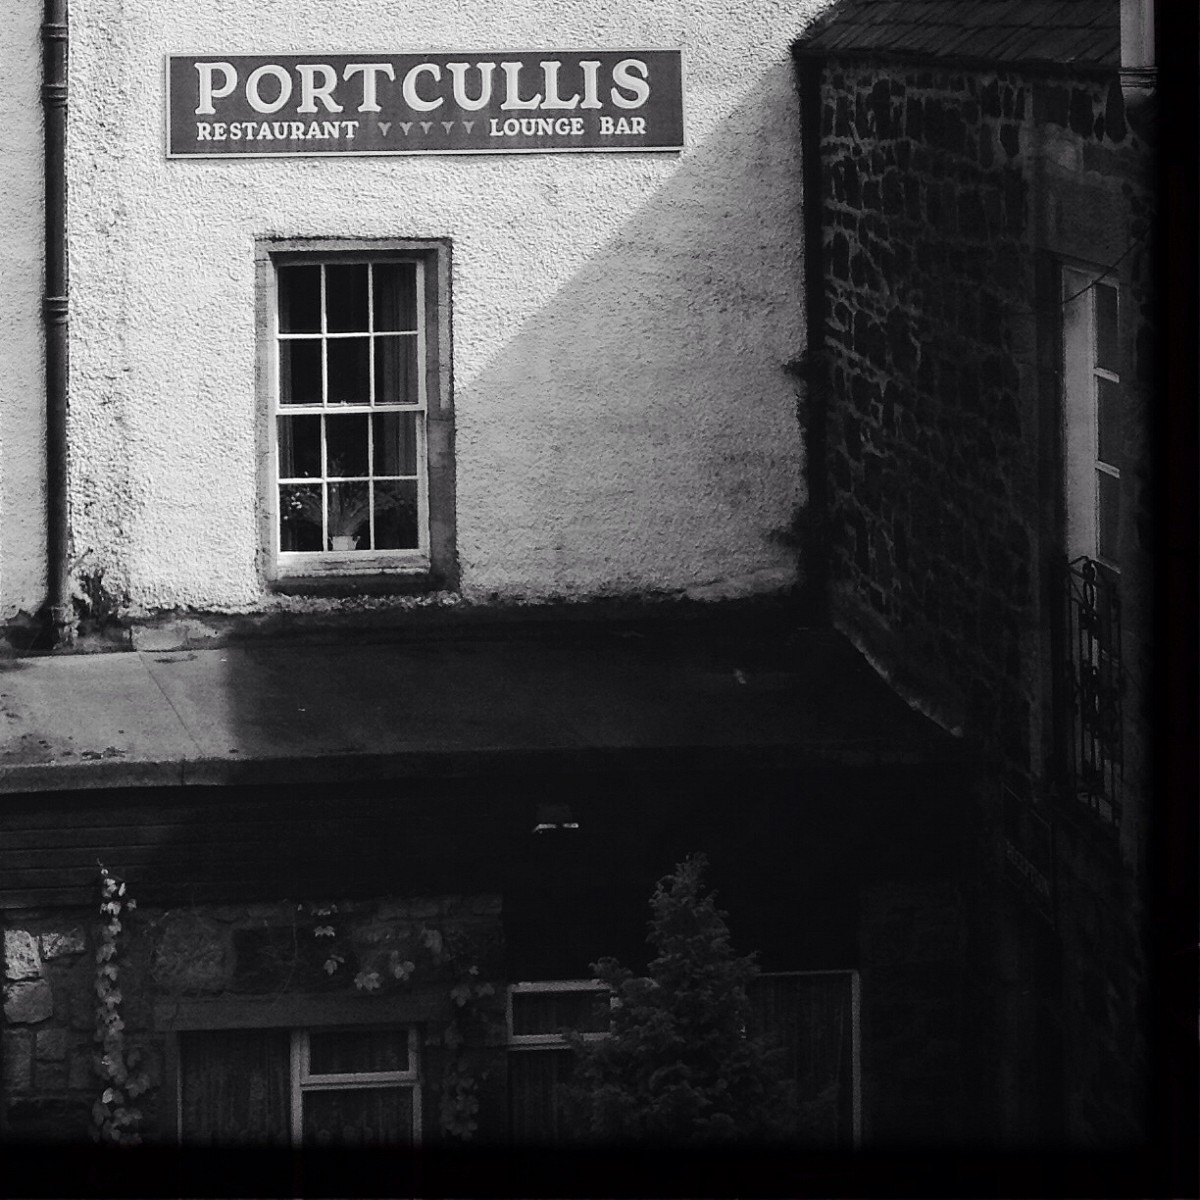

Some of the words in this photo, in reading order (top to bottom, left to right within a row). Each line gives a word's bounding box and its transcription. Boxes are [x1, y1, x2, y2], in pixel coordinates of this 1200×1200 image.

[194, 58, 651, 115] PORTCULLIS
[196, 120, 360, 141] RESTAURANT
[489, 117, 585, 137] LOUNGE
[599, 117, 647, 136] BAR
